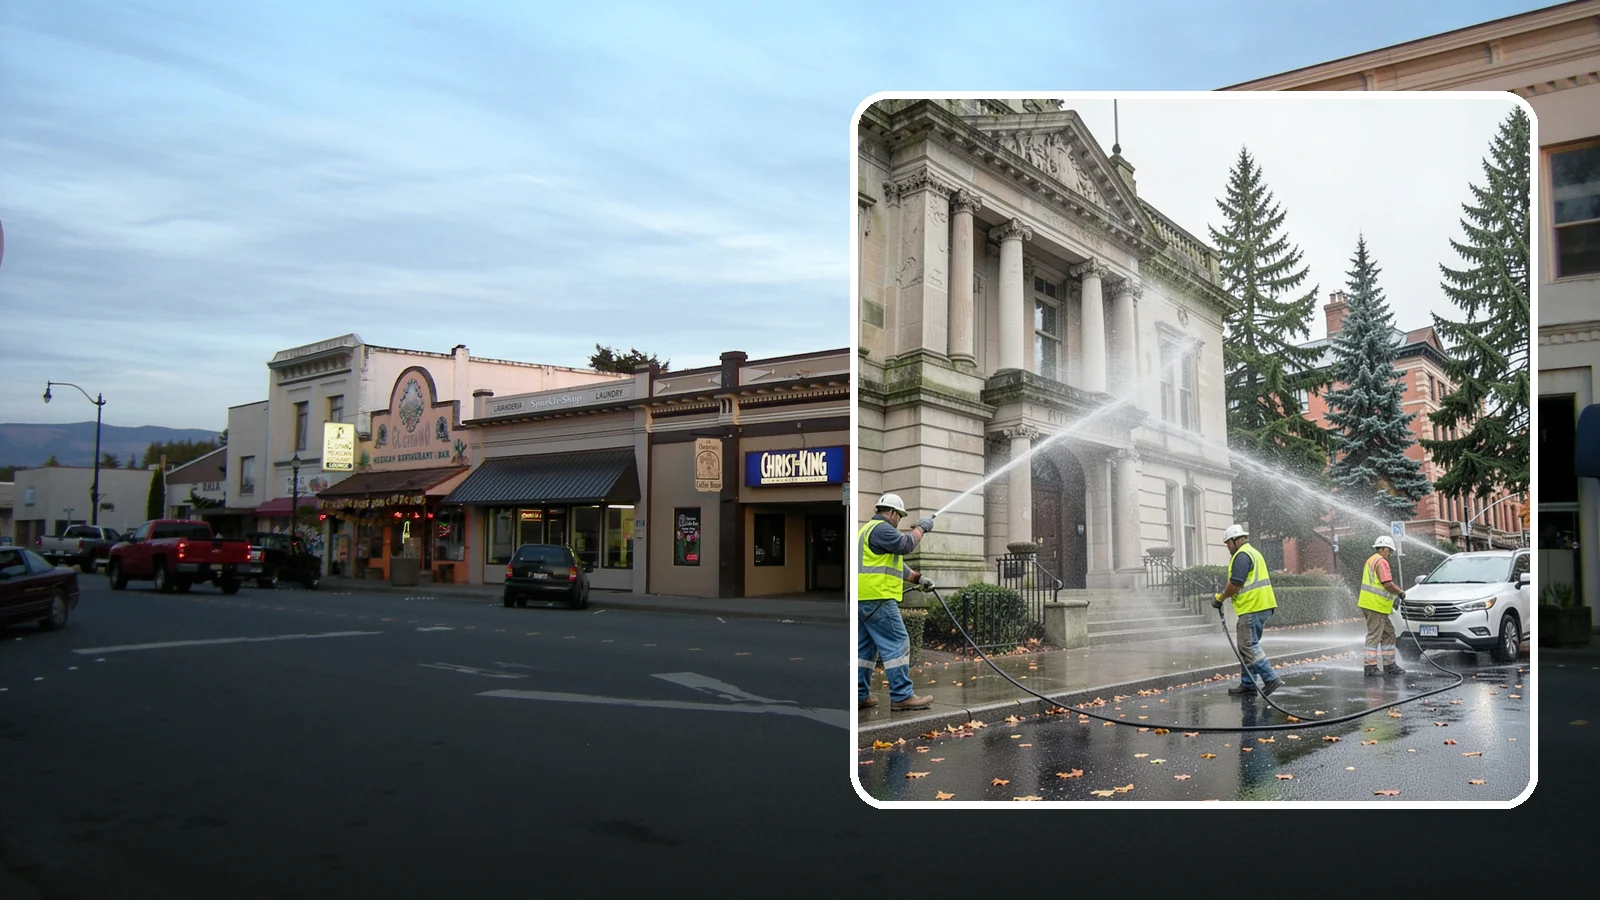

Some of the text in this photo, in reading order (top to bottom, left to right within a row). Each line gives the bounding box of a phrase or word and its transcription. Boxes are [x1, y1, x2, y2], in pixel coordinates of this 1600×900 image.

[561, 394, 582, 404] Shop
[595, 389, 623, 400] LAUNDRY
[373, 454, 396, 464] MEXICAN
[397, 451, 434, 463] RESTAURANT
[437, 450, 450, 459] BAR
[761, 450, 828, 478] CHRIST KING
